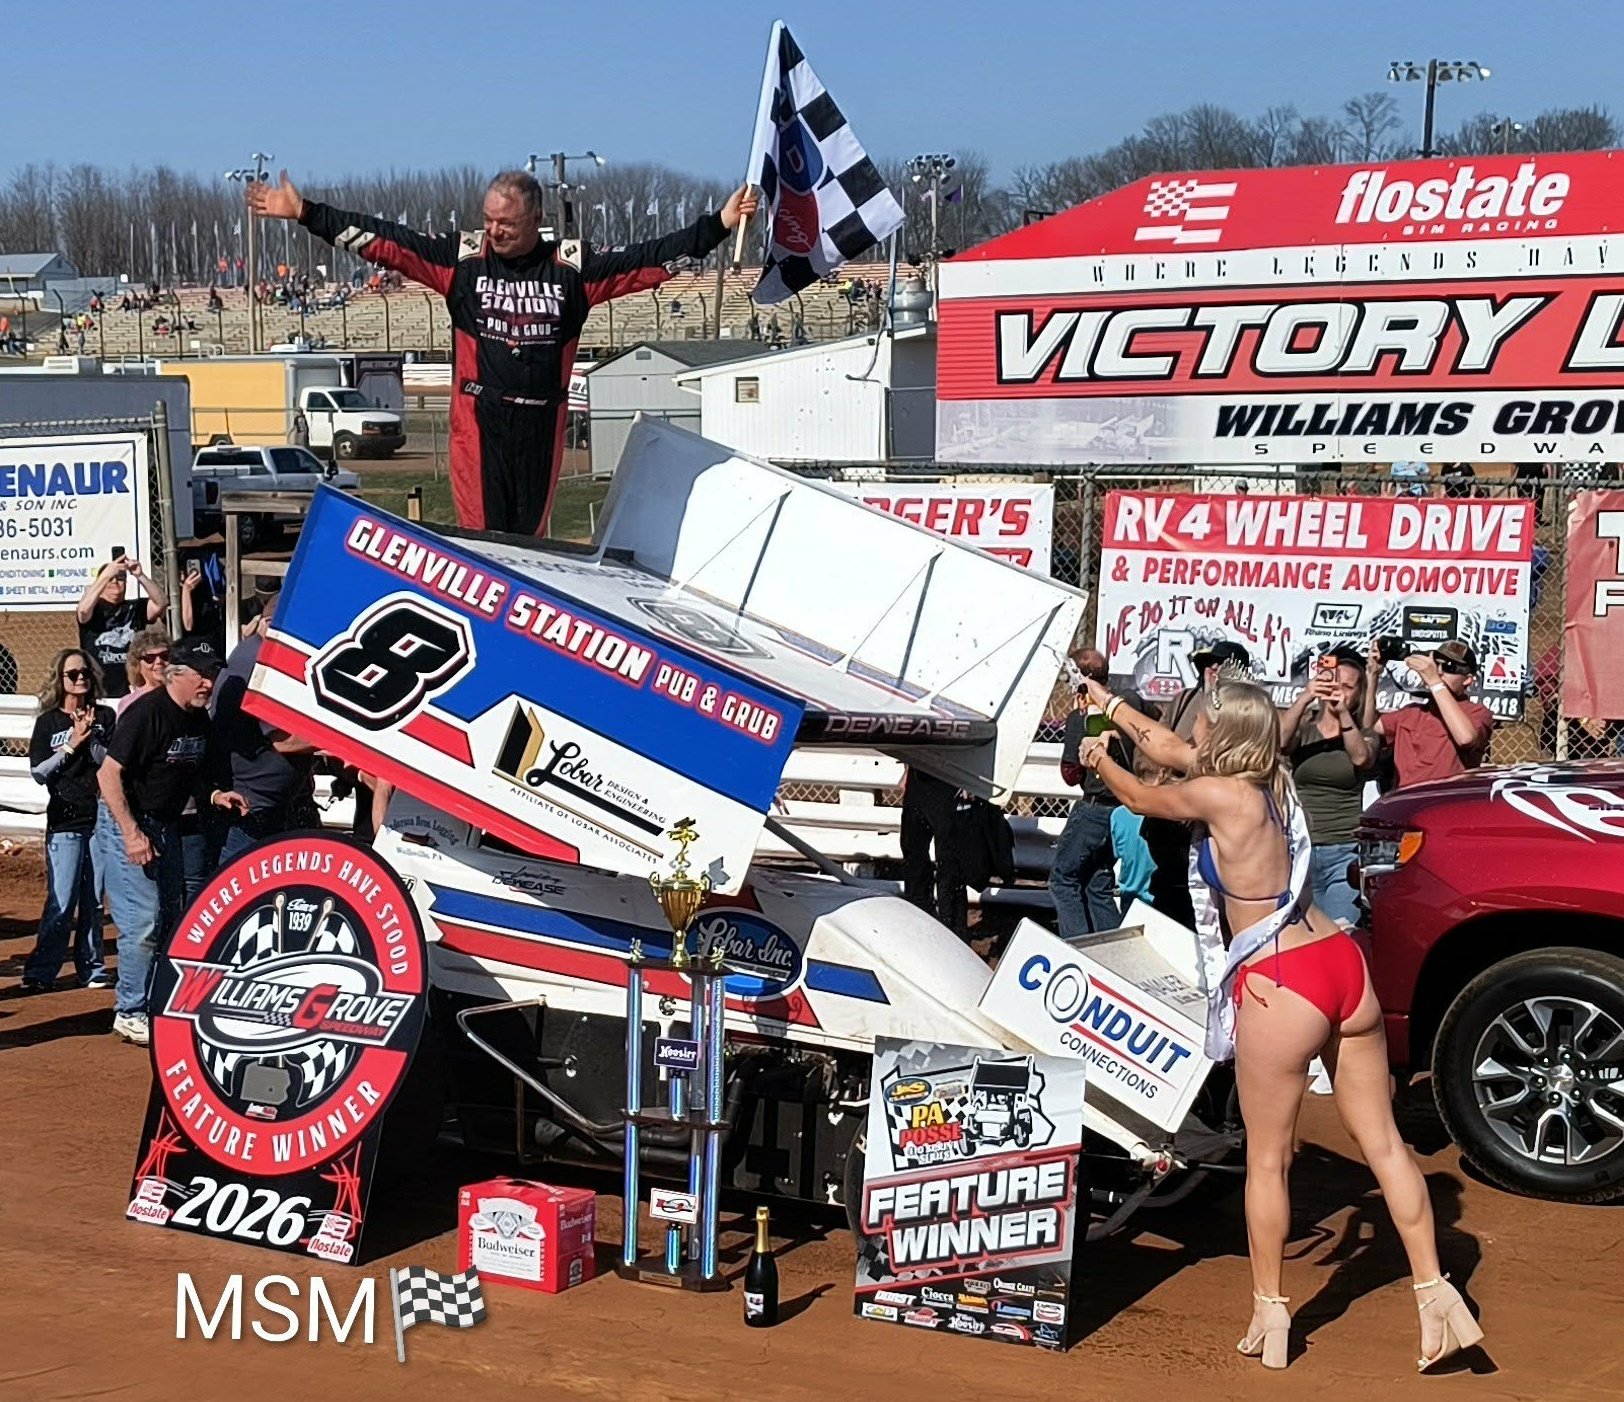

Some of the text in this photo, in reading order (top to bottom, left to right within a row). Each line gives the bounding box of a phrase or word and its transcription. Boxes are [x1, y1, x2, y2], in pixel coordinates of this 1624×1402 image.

[1335, 163, 1570, 223] flostate
[1402, 218, 1558, 236] SIM RACING
[1093, 258, 1227, 283] WHERE
[1273, 250, 1478, 277] LEGENDS
[475, 276, 565, 300] GLENVILLE
[481, 293, 561, 316] STATION
[1000, 294, 1555, 384] VICTORY
[1213, 399, 1624, 438] WILLIAMS GRO
[15, 499, 46, 511] SON
[1113, 495, 1527, 553] RV 4 WHEEL DRIVE
[1111, 555, 1520, 596] & PERFORMANCE AUTOMOTIVE
[347, 518, 505, 615] GLENVILLE
[508, 593, 654, 682] STATION
[655, 663, 698, 704] PUB
[699, 684, 718, 713] &
[720, 694, 781, 742] GRUB
[1105, 604, 1137, 661] WE
[1138, 599, 1164, 634] DO
[1168, 594, 1193, 621] IT
[1194, 596, 1221, 618] ON
[1304, 627, 1368, 639] Rhino Linings
[310, 596, 474, 732] 8
[824, 714, 971, 737] DEWEASE
[526, 740, 606, 792] Lobar
[510, 787, 554, 813] AFFILIATE
[556, 810, 569, 819] OF
[603, 789, 667, 824] ENGINEERING
[607, 779, 642, 801] DESIGN
[186, 850, 409, 976] WHERE LEGENDS HAVE STOOD
[289, 911, 312, 931] 1939
[757, 935, 793, 967] Inc.
[170, 966, 405, 1030] WILLIAMS GROVE
[1018, 954, 1192, 1075] CONDUIT
[318, 1019, 389, 1037] SPEEDWAY
[1059, 1031, 1159, 1100] CONNECTIONS
[165, 1058, 381, 1163] FEATURE WINNER
[899, 1121, 963, 1149] POSSE
[129, 1202, 168, 1220] flostate
[171, 1176, 312, 1246] 2026
[867, 1161, 1067, 1226] FEATURE
[560, 1213, 593, 1231] Budweiser
[891, 1208, 1057, 1264] WINNER
[309, 1237, 351, 1257] flostate
[477, 1236, 535, 1258] Budweiser
